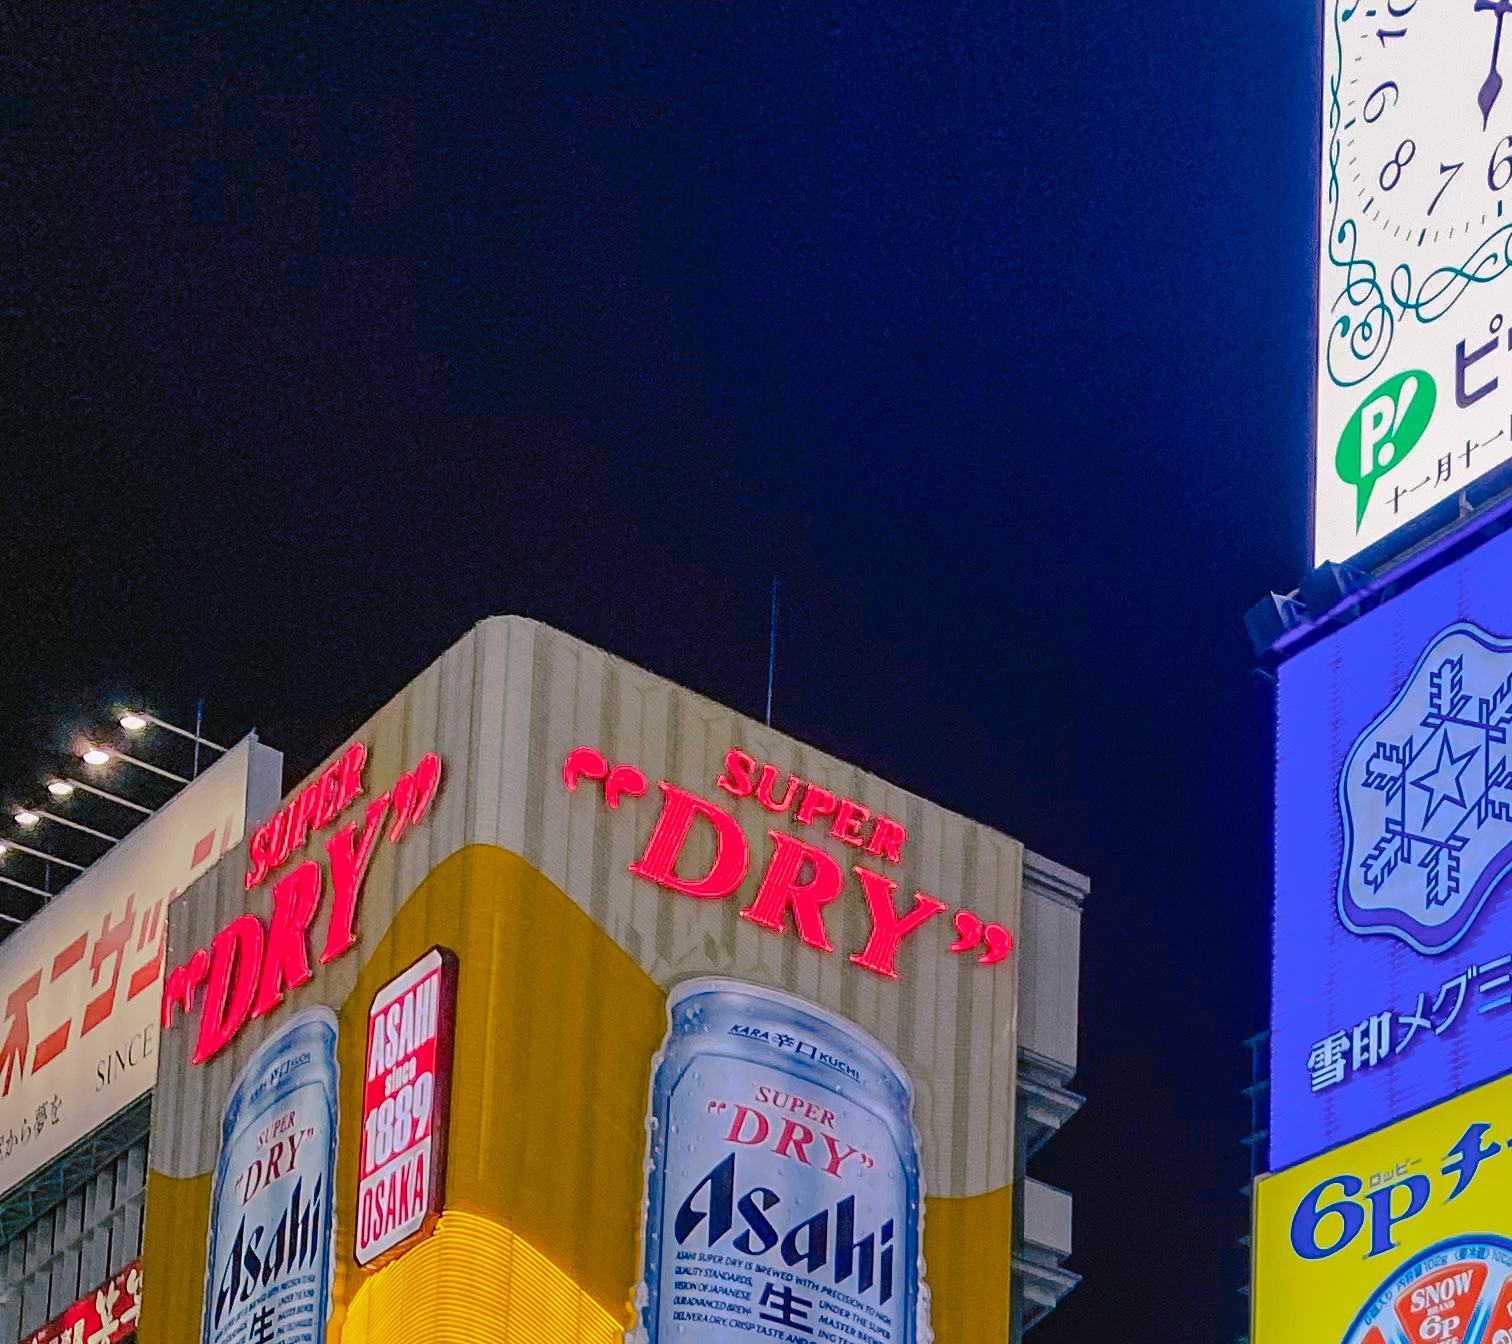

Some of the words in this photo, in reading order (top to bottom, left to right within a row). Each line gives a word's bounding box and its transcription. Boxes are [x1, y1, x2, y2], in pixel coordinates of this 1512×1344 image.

[1379, 139, 1416, 191] 8
[1427, 162, 1464, 216] 7
[245, 742, 367, 890] SUPER
[717, 748, 907, 864] SUPER
[368, 971, 438, 1083] ASAHI
[95, 1023, 154, 1093] SINCE
[384, 1056, 417, 1097] since
[819, 1052, 861, 1081] KUCHI
[257, 1110, 296, 1150] SUPER
[365, 1071, 433, 1174] 1889
[754, 1085, 835, 1128] SUPER
[360, 1153, 425, 1249] OSAKA
[214, 1173, 321, 1330] Asahi
[674, 1152, 895, 1306] Asahi
[698, 1252, 723, 1264] SUPER
[725, 1256, 742, 1268] DRY
[755, 1264, 794, 1282] BREWED
[795, 1275, 820, 1291] WITH
[821, 1285, 864, 1311] PRECISION
[1410, 1269, 1474, 1313] SNOW
[757, 1324, 784, 1340] TASTE
[758, 1282, 814, 1334] 生
[819, 1300, 850, 1318] UNDER
[852, 1310, 867, 1326] THE
[819, 1314, 856, 1336] MASTER
[1419, 1314, 1461, 1340] 6P
